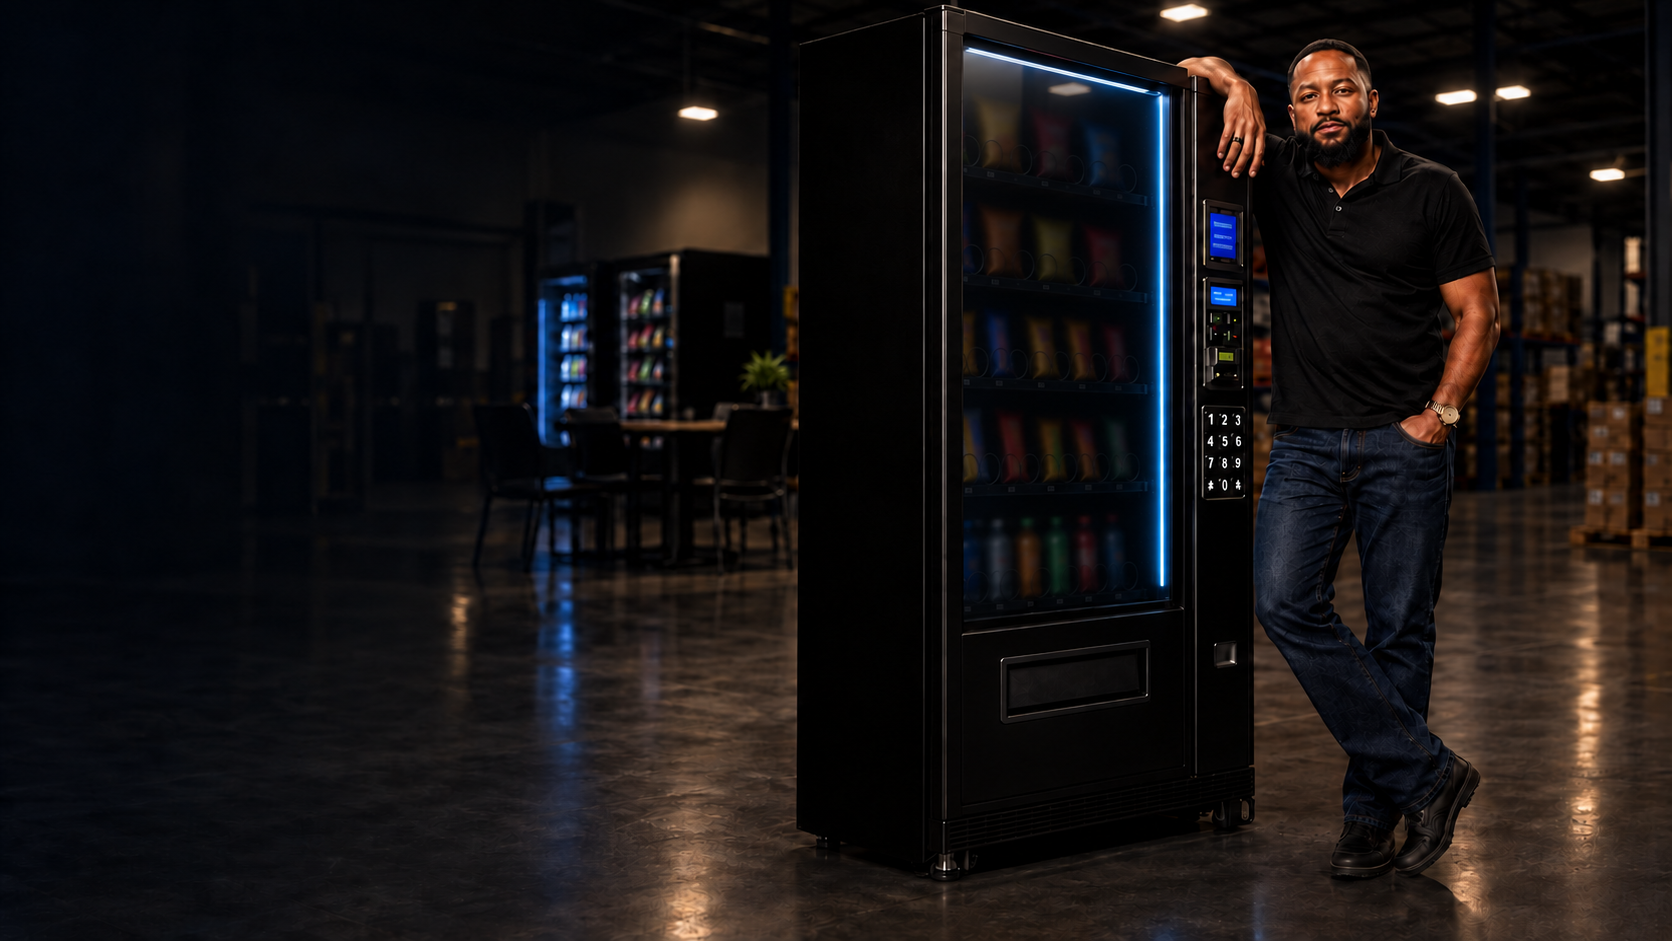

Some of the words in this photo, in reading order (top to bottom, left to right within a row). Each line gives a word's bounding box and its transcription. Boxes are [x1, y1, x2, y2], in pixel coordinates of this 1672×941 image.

[1208, 413, 1213, 425] 1
[1222, 414, 1228, 425] 2
[1235, 414, 1241, 425] 3
[1207, 435, 1213, 446] 4
[1222, 436, 1228, 446] 5
[1235, 436, 1241, 446] 6
[1208, 457, 1214, 468] 7
[1222, 457, 1228, 468] 8
[1235, 457, 1241, 468] 9
[1222, 479, 1228, 491] 0
